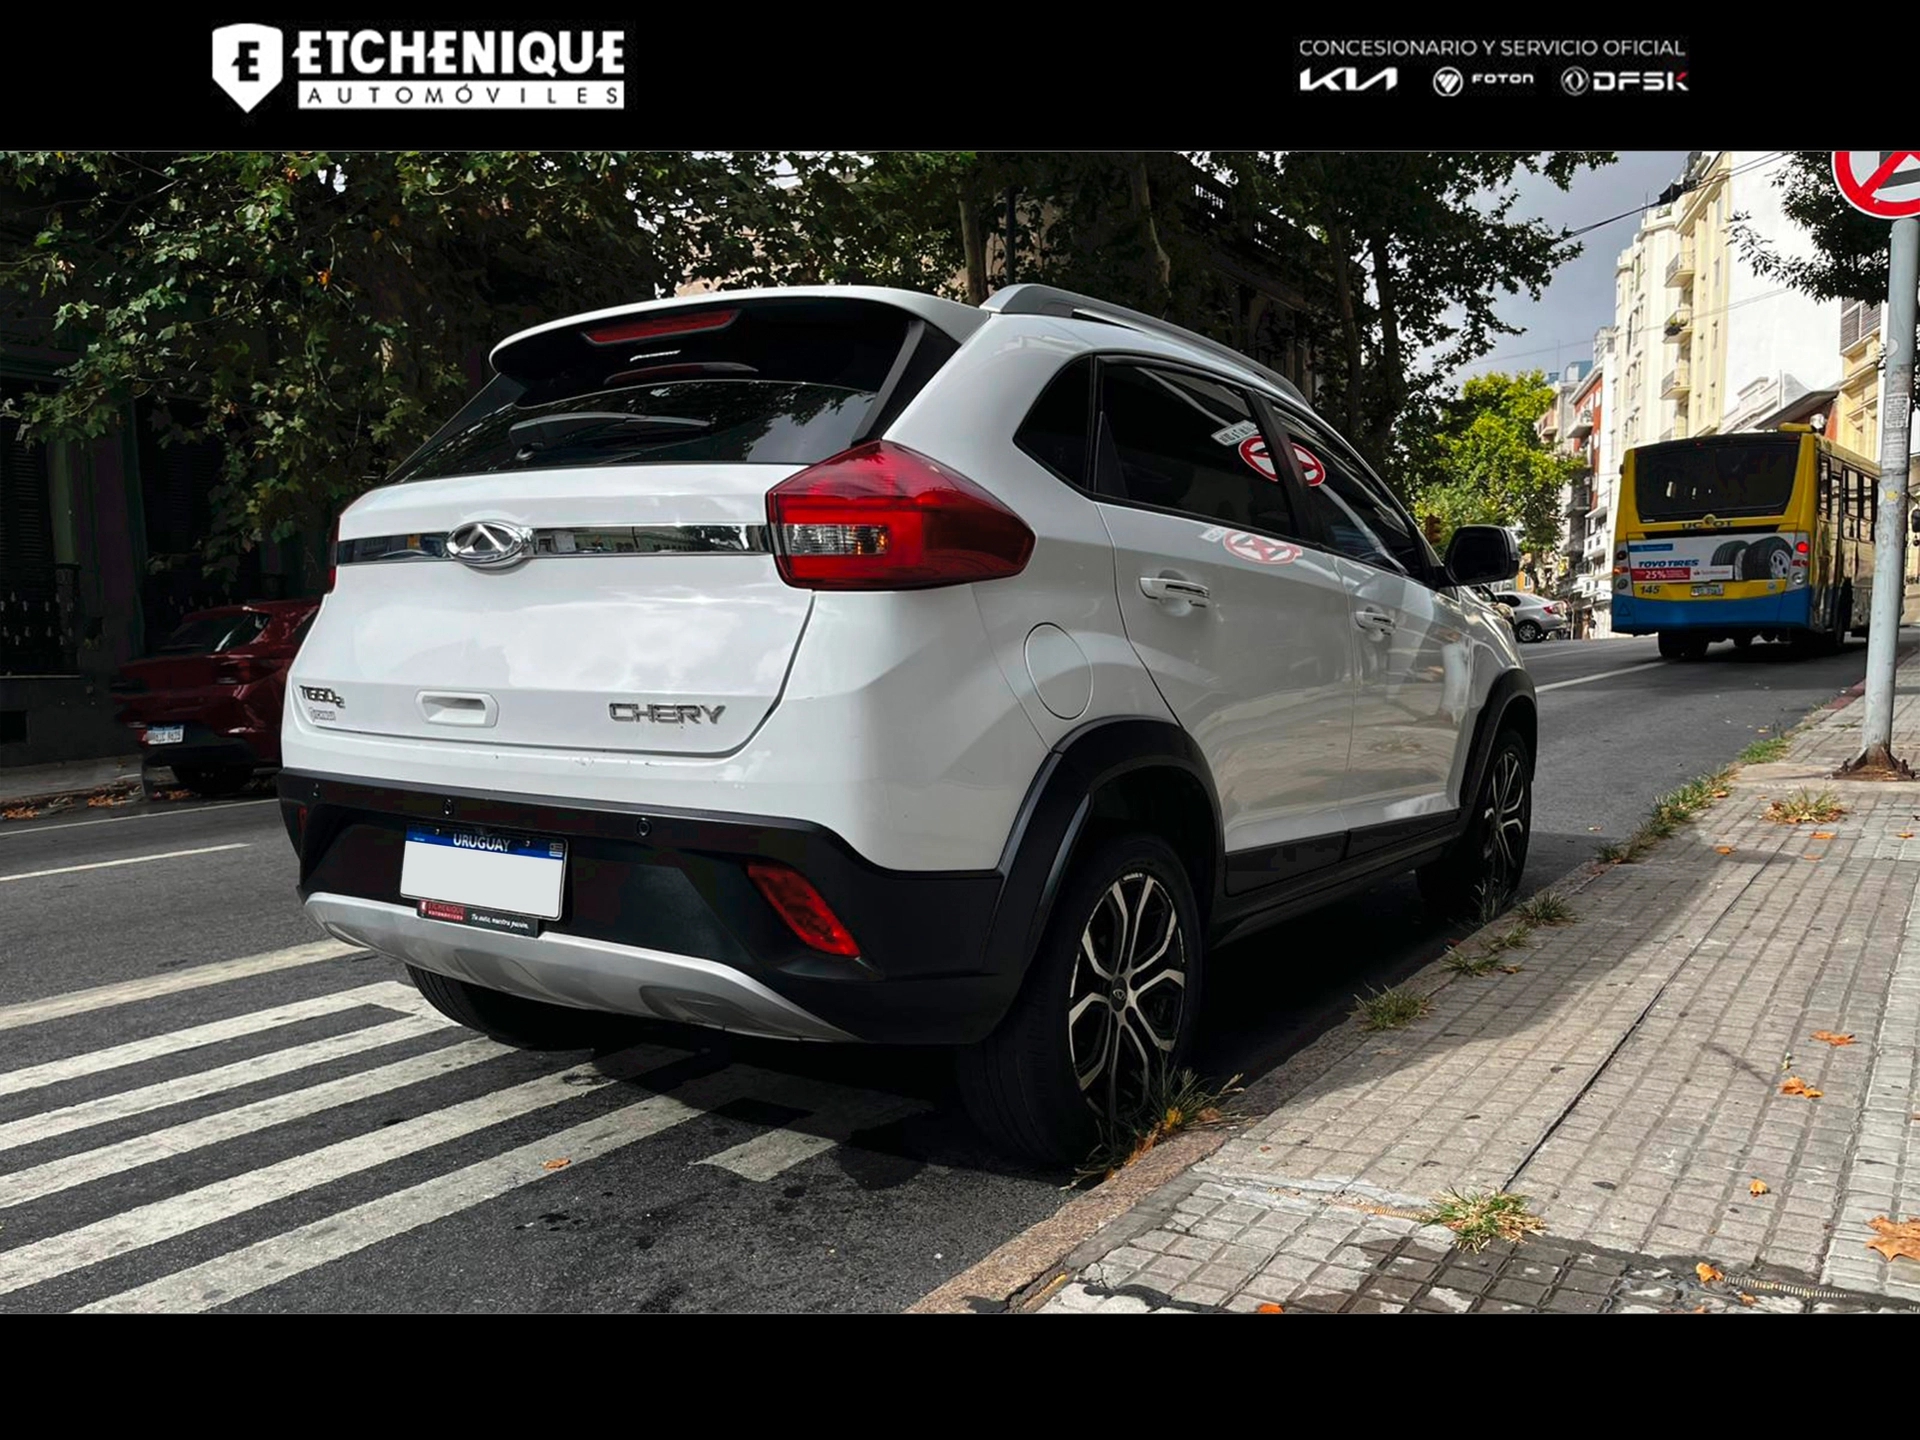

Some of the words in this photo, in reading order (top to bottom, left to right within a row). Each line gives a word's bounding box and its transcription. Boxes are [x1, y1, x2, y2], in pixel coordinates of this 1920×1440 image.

[1668, 559, 1699, 567] TIRES
[1645, 569, 1667, 580] 25%
[1641, 585, 1660, 594] 145
[608, 702, 726, 724] CHERY
[453, 833, 511, 852] URUGUAY
